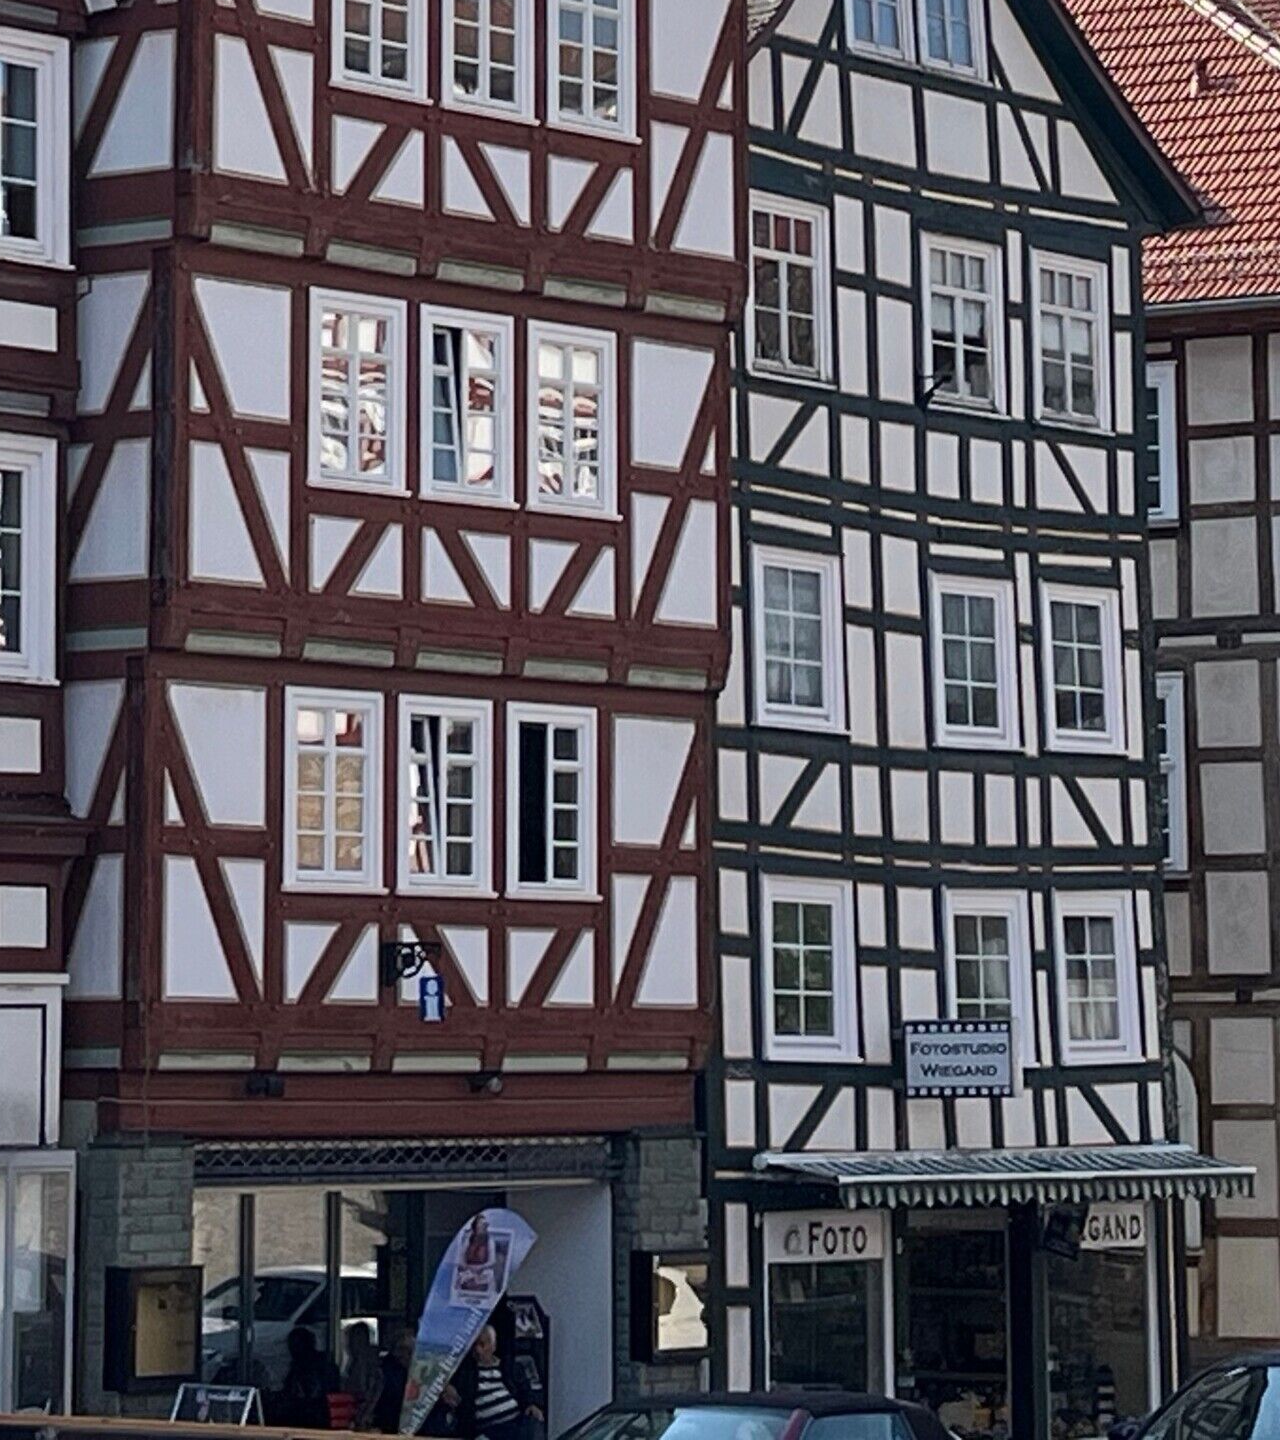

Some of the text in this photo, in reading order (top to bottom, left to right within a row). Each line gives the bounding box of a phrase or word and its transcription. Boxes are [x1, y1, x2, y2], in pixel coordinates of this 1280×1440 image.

[910, 1042, 1007, 1056] FOTOSTUDIO
[920, 1063, 998, 1077] WIEGAND
[1081, 1214, 1142, 1241] GAND
[808, 1221, 868, 1255] FOTO
